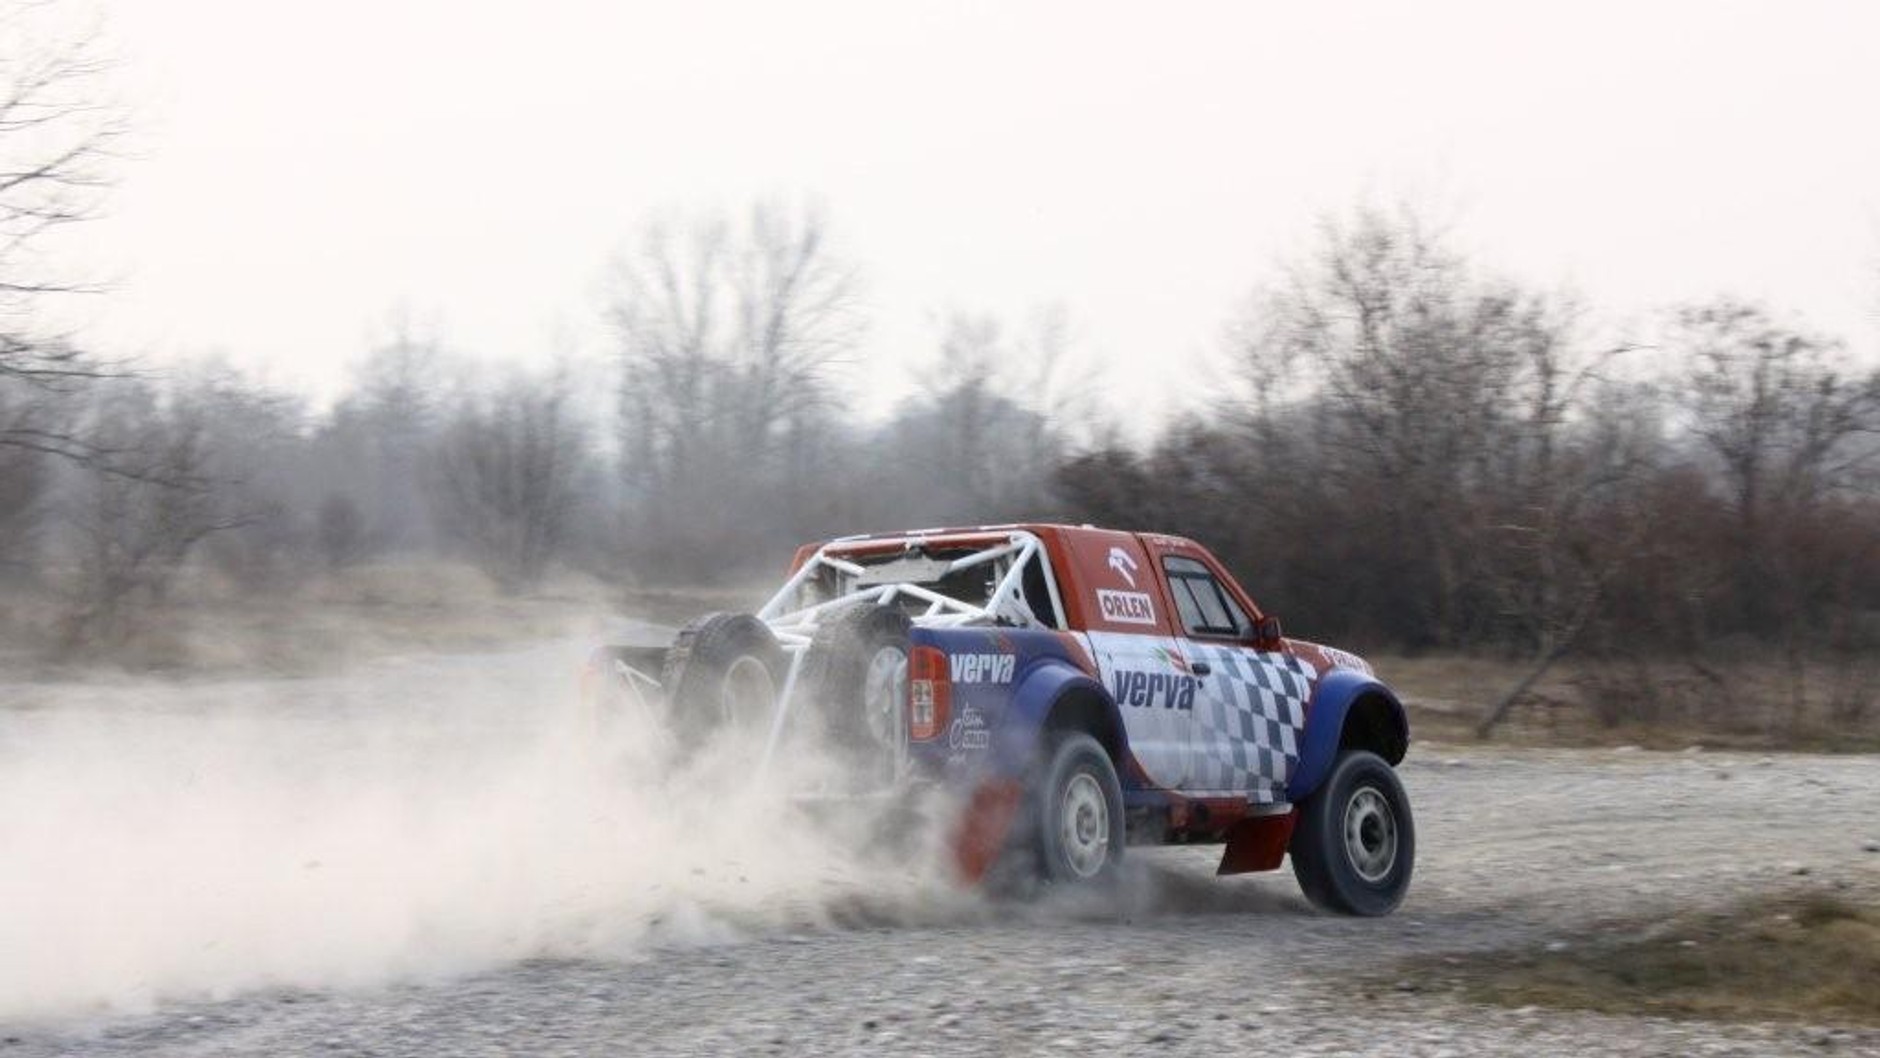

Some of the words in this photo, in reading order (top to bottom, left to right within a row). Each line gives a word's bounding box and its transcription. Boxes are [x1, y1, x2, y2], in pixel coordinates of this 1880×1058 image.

[1103, 595, 1151, 618] ORLEN
[950, 654, 1016, 683] verva
[1115, 670, 1196, 710] verva
